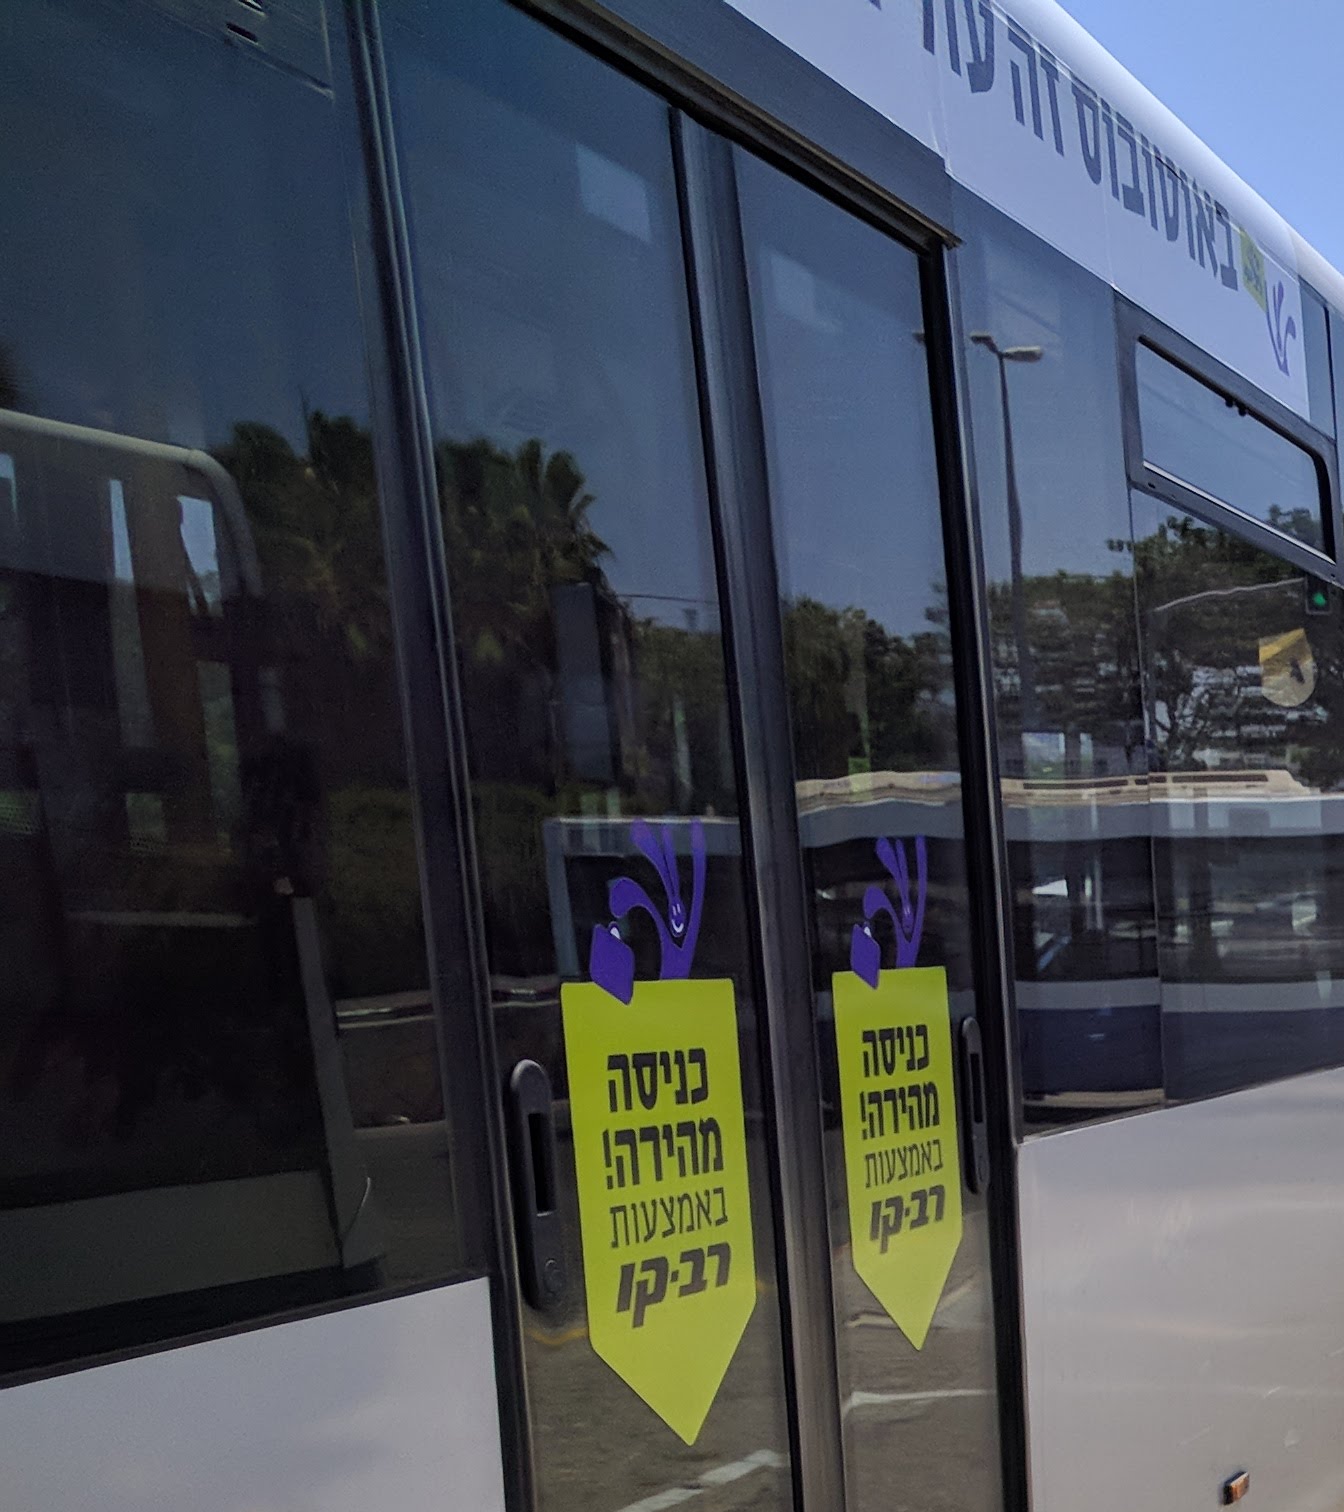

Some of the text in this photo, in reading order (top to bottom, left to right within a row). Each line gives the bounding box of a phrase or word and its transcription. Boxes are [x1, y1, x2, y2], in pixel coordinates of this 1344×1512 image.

[1007, 15, 1064, 156] זה
[1072, 77, 1238, 291] באוטובוס
[607, 1046, 709, 1113] כניסה
[862, 1023, 930, 1078] כניסה
[859, 1081, 941, 1140] מהירה!
[603, 1116, 724, 1191] מהירה!
[864, 1136, 943, 1189] באמצעות
[610, 1186, 728, 1248] באמצעות
